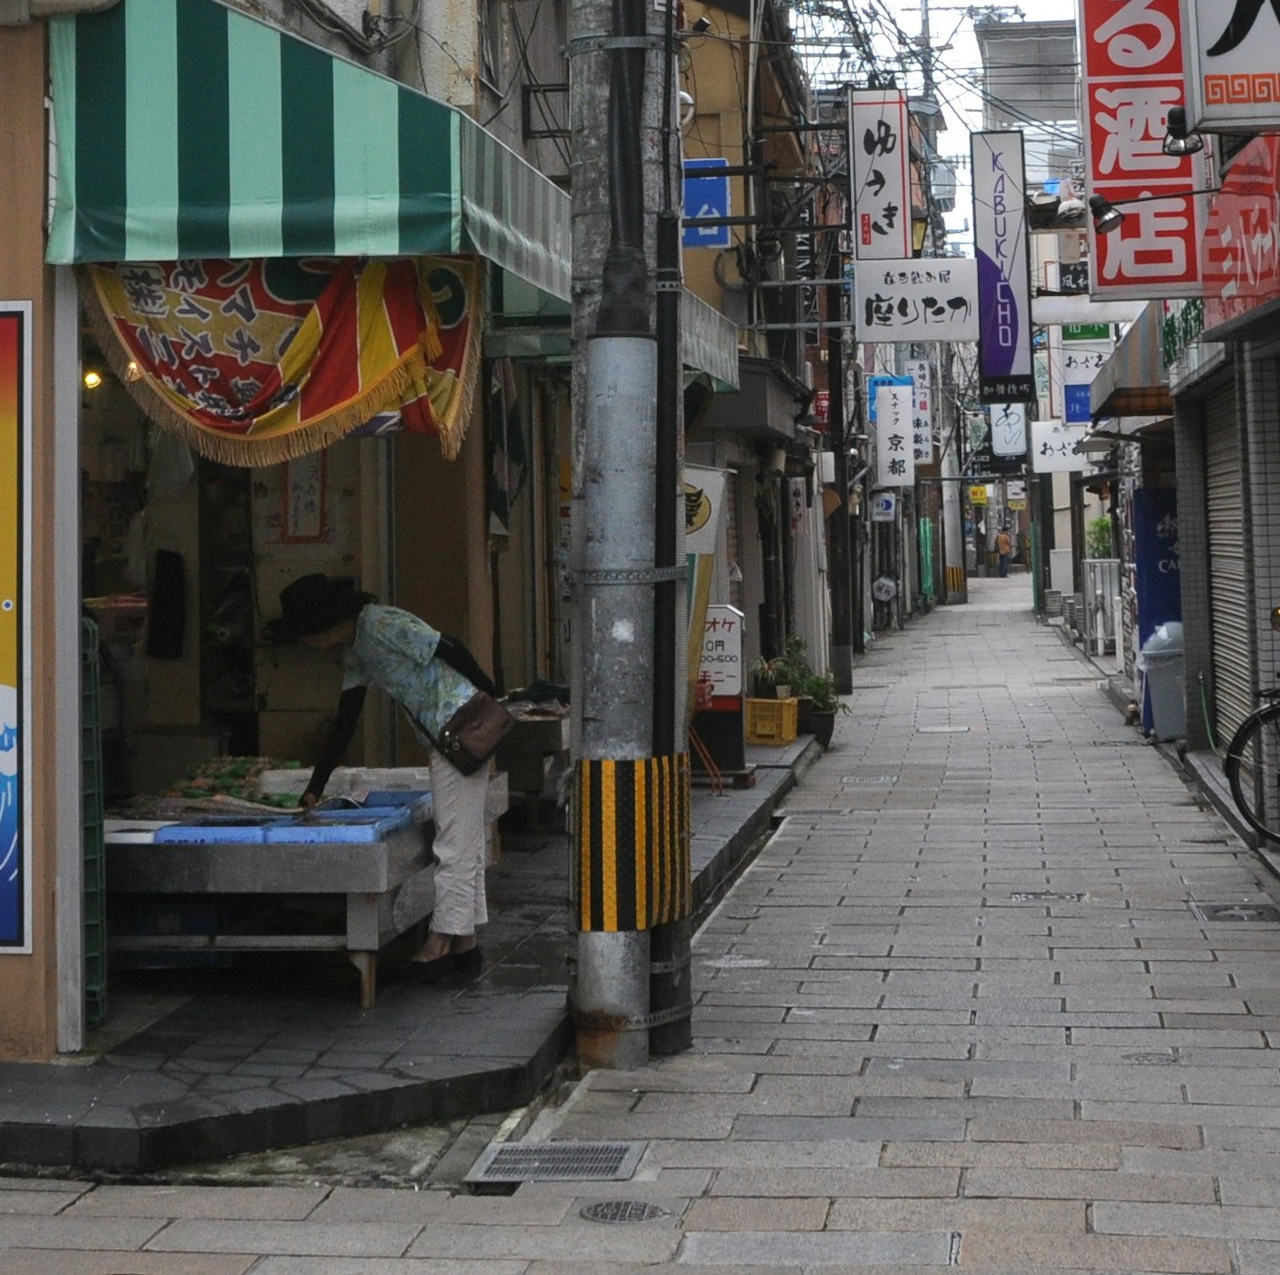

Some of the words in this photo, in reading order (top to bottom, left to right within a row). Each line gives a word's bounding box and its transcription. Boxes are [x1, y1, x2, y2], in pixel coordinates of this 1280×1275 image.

[862, 119, 900, 236] ゆうき
[991, 151, 1012, 347] KABUKICHO
[887, 433, 907, 477] 京都
